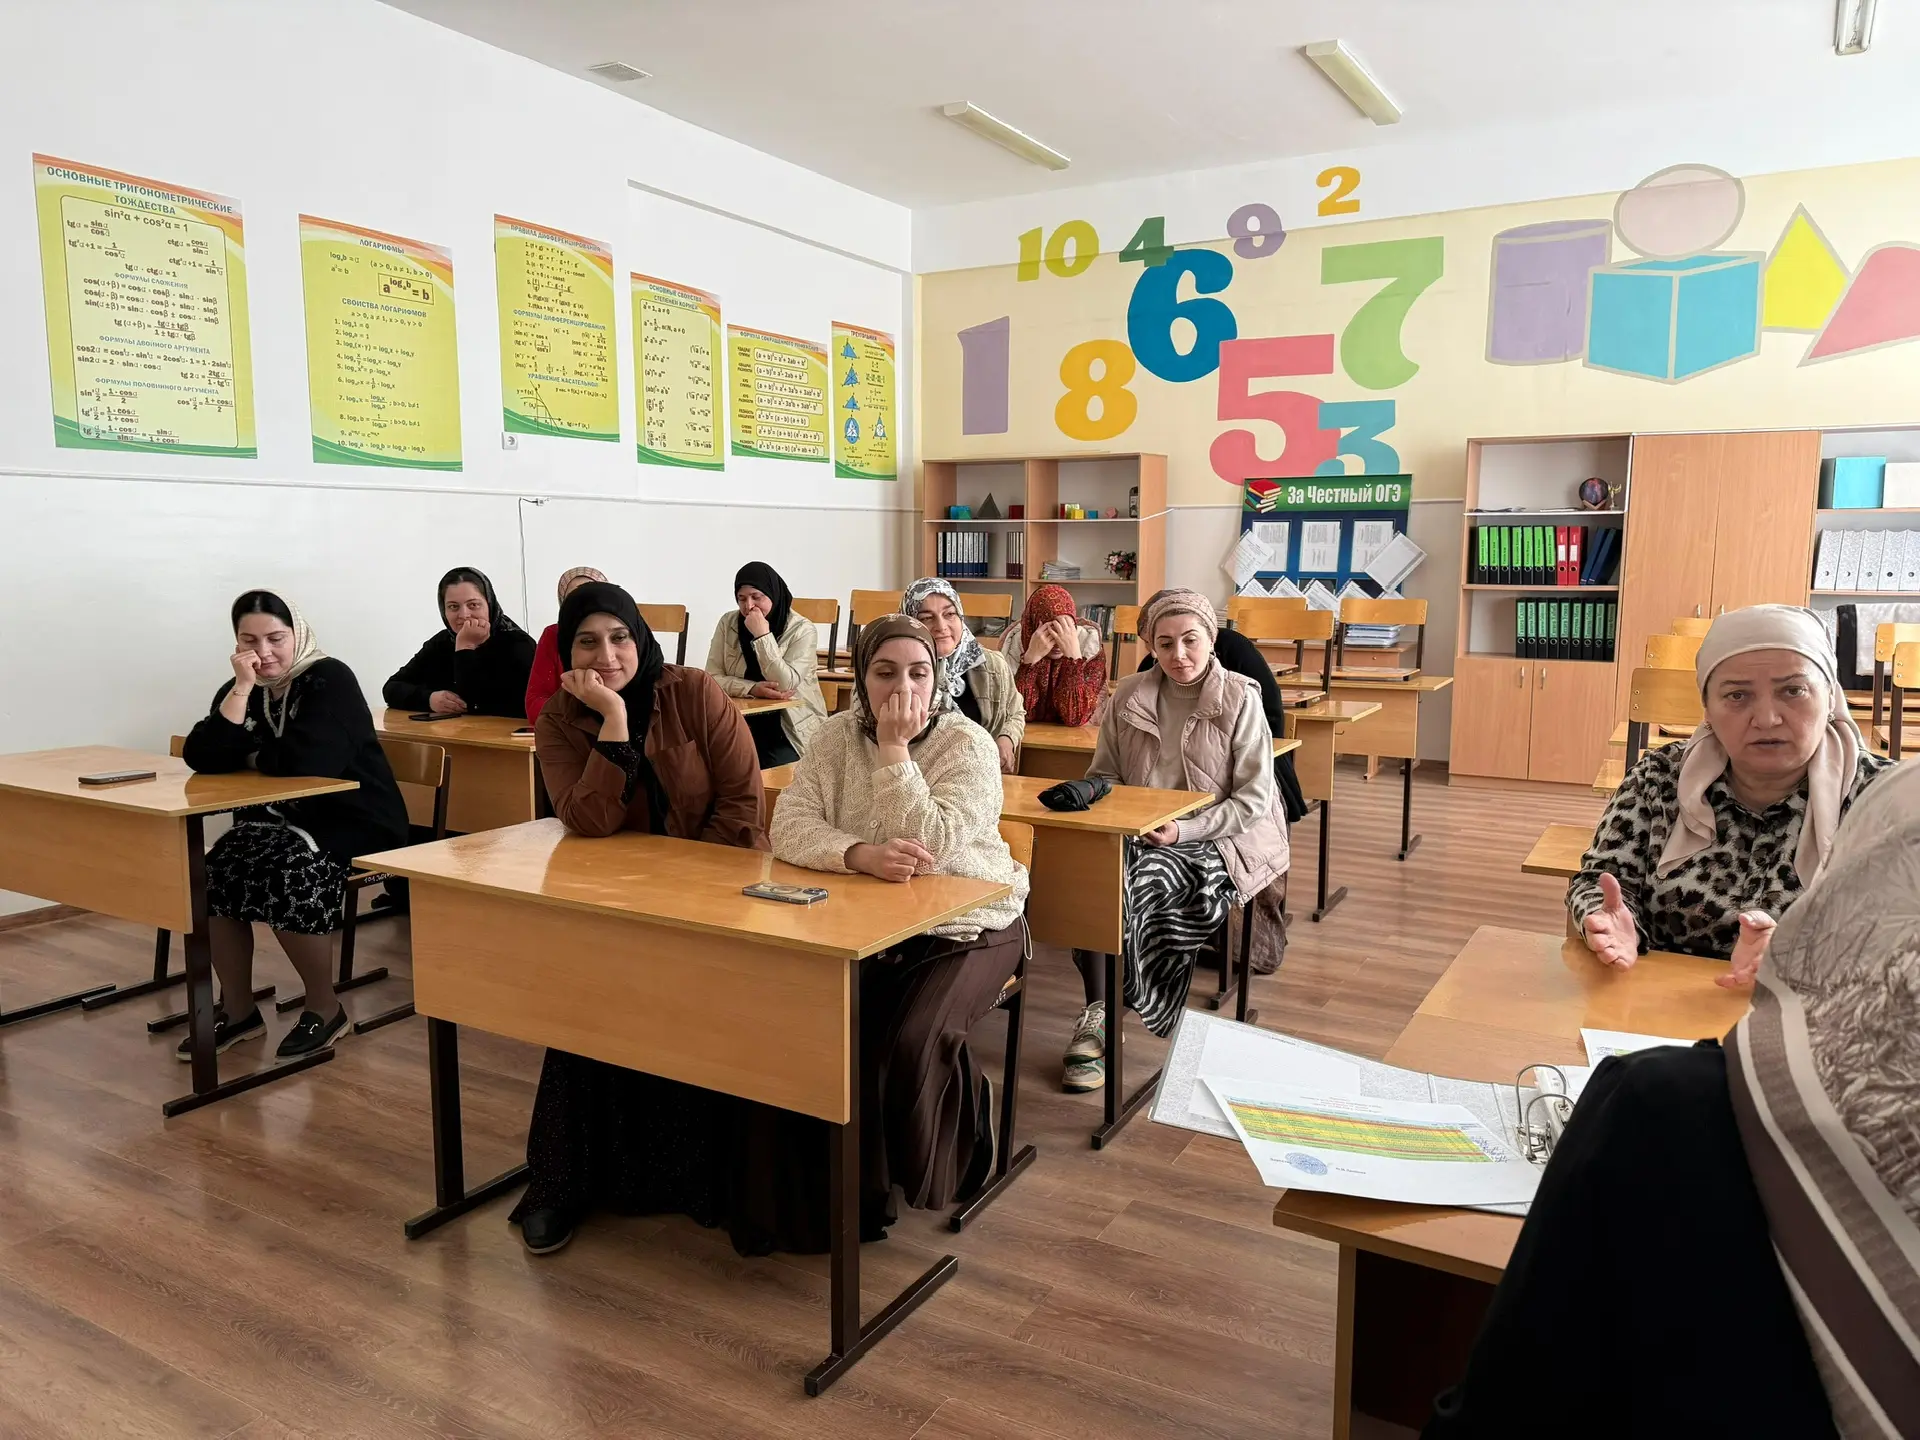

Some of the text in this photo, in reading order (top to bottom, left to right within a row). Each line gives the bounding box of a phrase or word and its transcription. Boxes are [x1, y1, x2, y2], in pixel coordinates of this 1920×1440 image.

[46, 166, 232, 214] ОСНОВНЫЕ ТРИГОНОМЕТРИЧЕСКИЕ
[114, 194, 175, 215] ТОЖДЕСТВА
[1316, 166, 1361, 216] 2
[183, 223, 188, 232] 1
[359, 239, 404, 254] ЛОГАРИФМЫ
[1017, 219, 1100, 282] 10
[1119, 216, 1175, 268] 4
[1227, 203, 1286, 260] 9
[114, 272, 188, 289] ФОРМУЛЫ СЛОЖЕНИЯ
[380, 304, 426, 317] ЛОГАРИФМОВ
[1127, 248, 1238, 383] 6
[1321, 236, 1444, 391] 7
[99, 335, 135, 345] ФОРМУЛЫ
[173, 344, 210, 354] АРГУМЕНТА
[95, 377, 131, 386] ФОРМУЛЫ
[183, 386, 219, 394] АРГУМЕНТА
[957, 315, 1010, 436] 1
[1054, 339, 1138, 441] 8
[1209, 333, 1342, 486] 5
[1314, 400, 1400, 477] 3
[1287, 484, 1401, 504] За Честный ОГЭ
